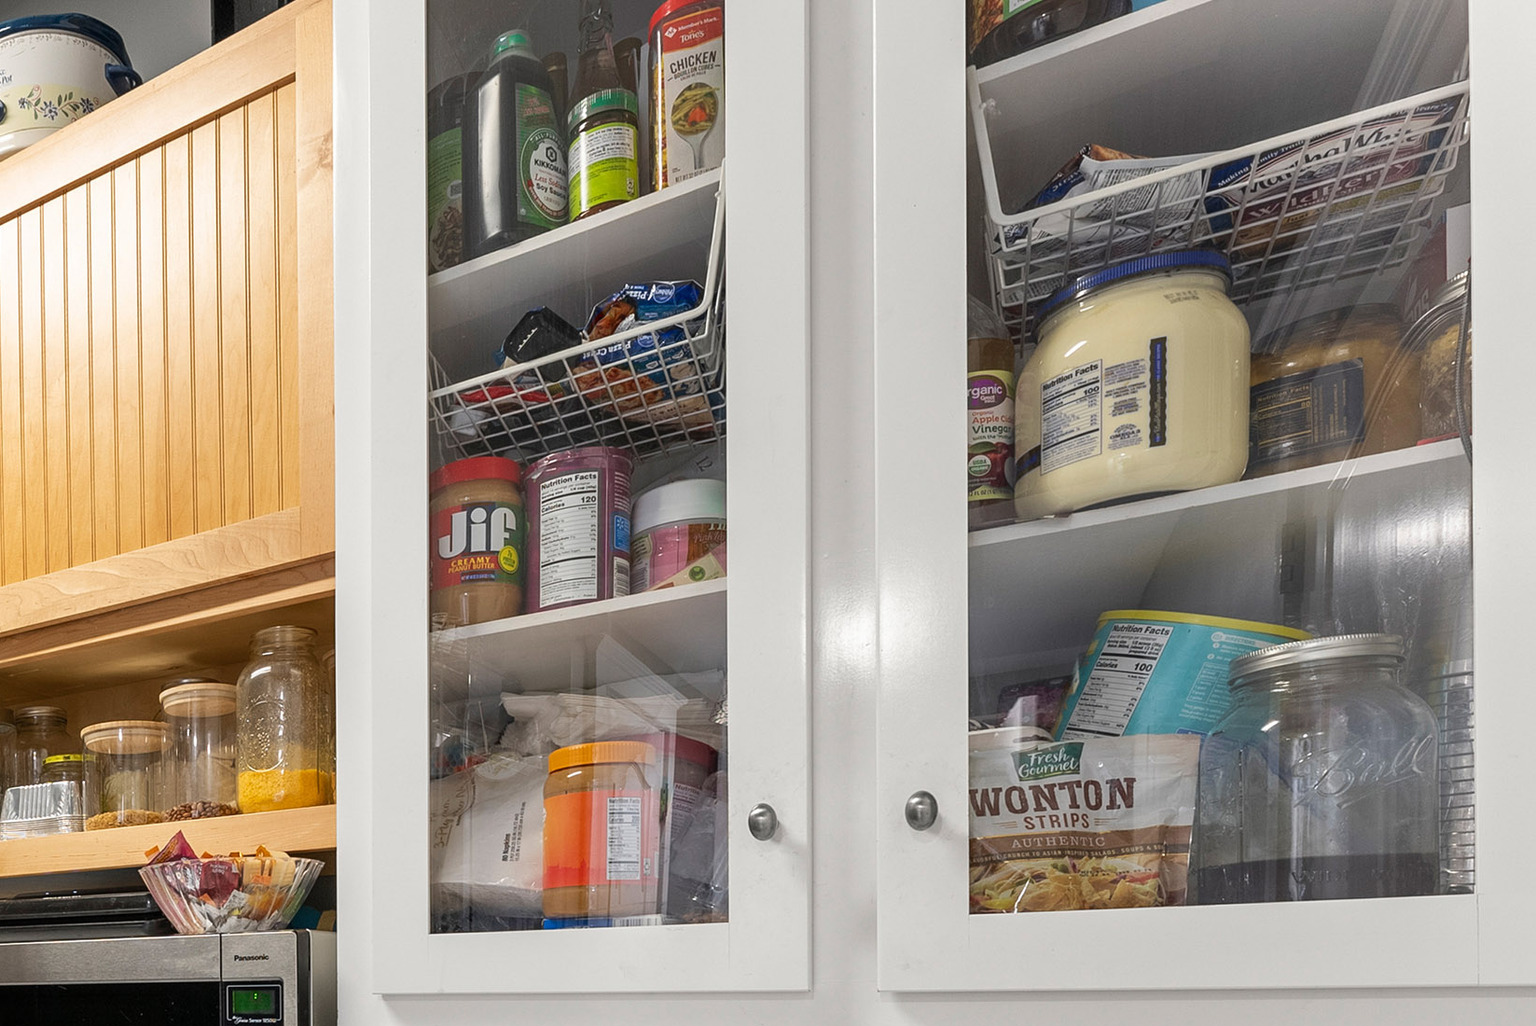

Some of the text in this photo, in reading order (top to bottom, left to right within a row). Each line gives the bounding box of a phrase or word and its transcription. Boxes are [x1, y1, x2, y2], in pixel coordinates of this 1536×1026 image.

[670, 50, 717, 74] CHICKEN
[1218, 165, 1250, 187] Making
[1042, 371, 1074, 391] Nutrition
[1075, 363, 1099, 378] Facts
[1083, 386, 1100, 397] 100
[972, 415, 1000, 425] Apple
[541, 473, 597, 490] Nutrition Facts
[580, 495, 597, 504] 120
[439, 507, 516, 558] Jif
[448, 563, 495, 575] PEANUT BUTTER
[451, 556, 491, 568] CREAMY
[1113, 624, 1171, 636] Nutrition Facts
[1095, 660, 1153, 673] Calories 100
[1027, 748, 1069, 767] Fresh
[1018, 760, 1079, 778] Gourmet
[968, 777, 1137, 817] WONTON
[1024, 813, 1090, 830] STRIPS
[1011, 836, 1106, 849] AUTHENTIC
[233, 953, 270, 962] Panasonic
